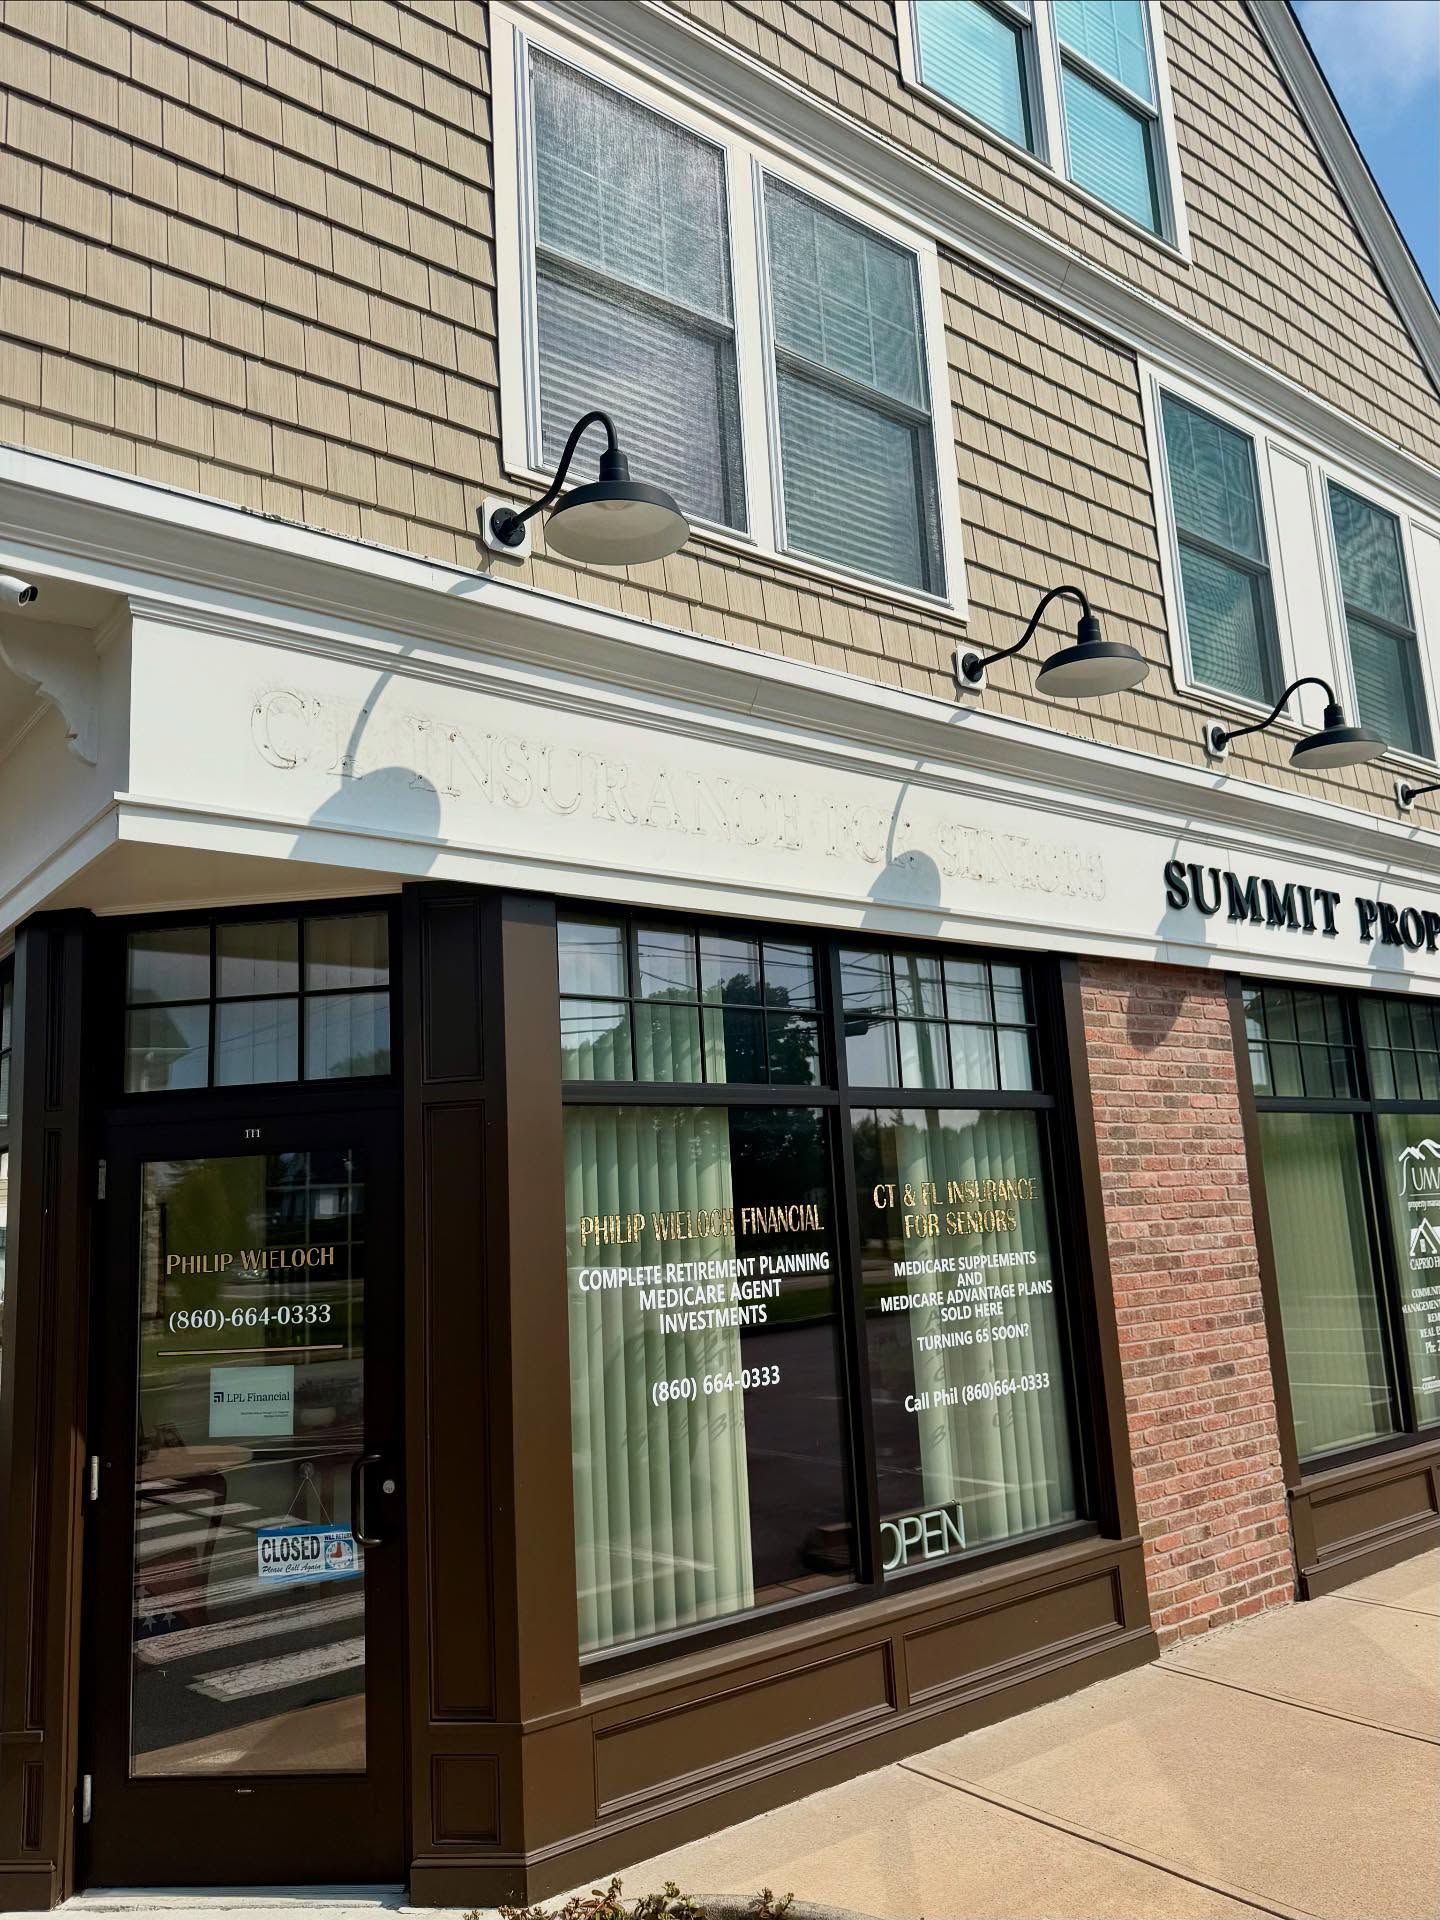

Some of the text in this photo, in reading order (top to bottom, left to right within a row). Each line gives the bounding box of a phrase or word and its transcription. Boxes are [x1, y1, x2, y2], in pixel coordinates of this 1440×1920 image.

[1164, 860, 1440, 951] SUMMIT PROP
[873, 1177, 1039, 1209] CT & FL INSURANCE
[580, 1203, 825, 1247] PHILIP WIELOCH FINANCIAL
[904, 1208, 1017, 1239] FOR SENIORS
[166, 1246, 334, 1275] PHILIP WIELOCH
[578, 1251, 830, 1292] COMPLETE RETIREMENT PLANNING
[894, 1250, 1037, 1277] MEDICARE SUPPLEMENTS
[639, 1278, 782, 1311] MEDICARE AGENT
[880, 1279, 1053, 1312] MEDICARE ADVANTAGE PLANS
[957, 1272, 983, 1288] AND
[169, 1304, 331, 1333] (860)-664-0333
[659, 1304, 767, 1335] INVESTMENTS
[941, 1301, 1003, 1322] SOLD HERE
[917, 1323, 1030, 1351] TURNING 65 SOON?
[227, 1391, 290, 1403] LPL Financial
[652, 1365, 781, 1406] (860) 664-0333
[904, 1371, 1050, 1412] Call Phil (860)664-0333
[262, 1535, 321, 1563] CLOSED
[262, 1562, 322, 1573] Please Call Again
